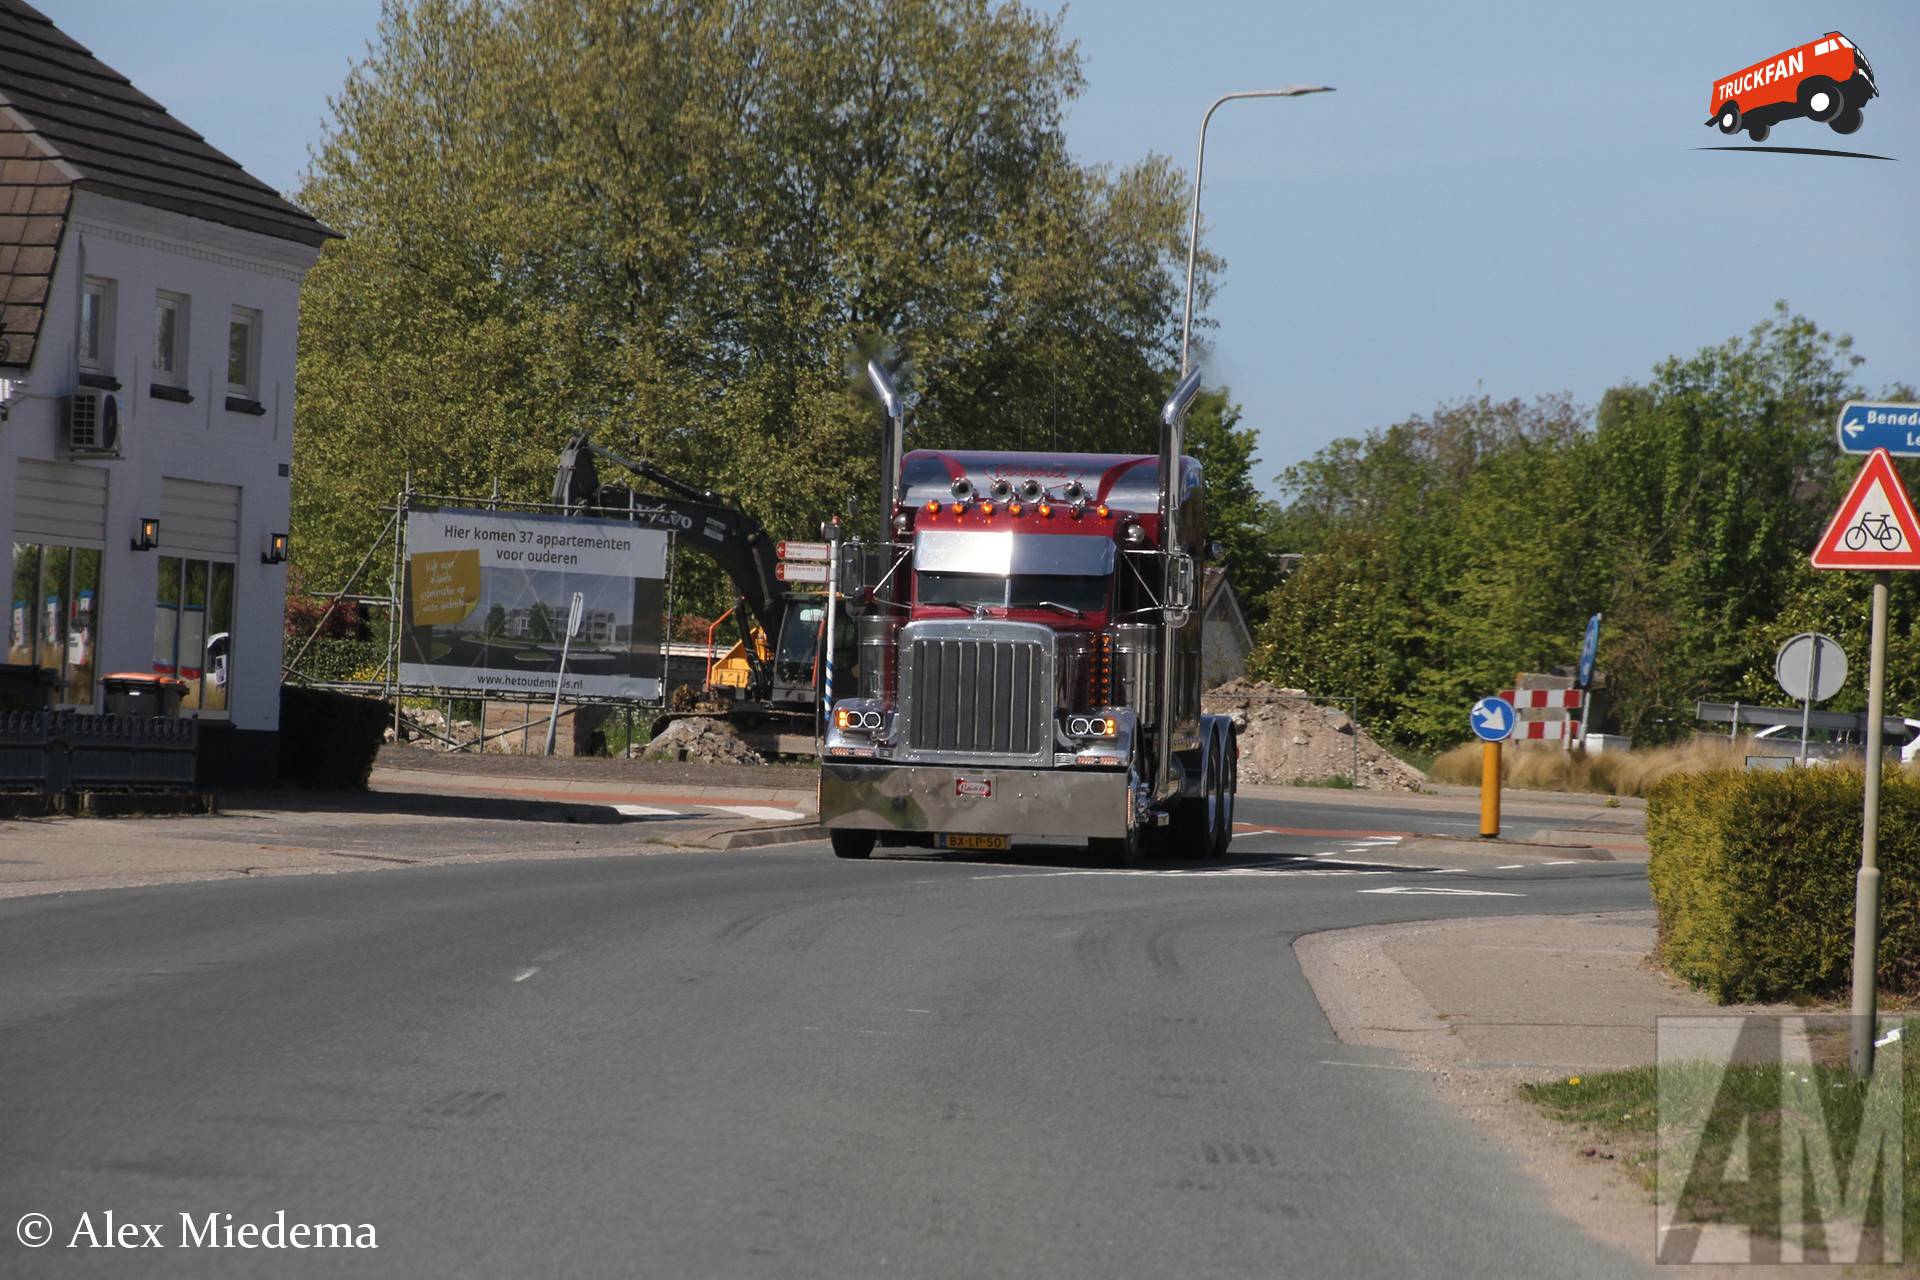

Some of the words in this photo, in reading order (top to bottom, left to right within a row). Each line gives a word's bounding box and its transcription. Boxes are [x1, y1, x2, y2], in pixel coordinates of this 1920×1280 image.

[444, 525, 471, 539] Hier
[474, 527, 516, 543] komen
[519, 531, 534, 543] 37
[536, 533, 631, 551] appartementen
[496, 549, 524, 561] voor
[527, 551, 578, 565] ouderen
